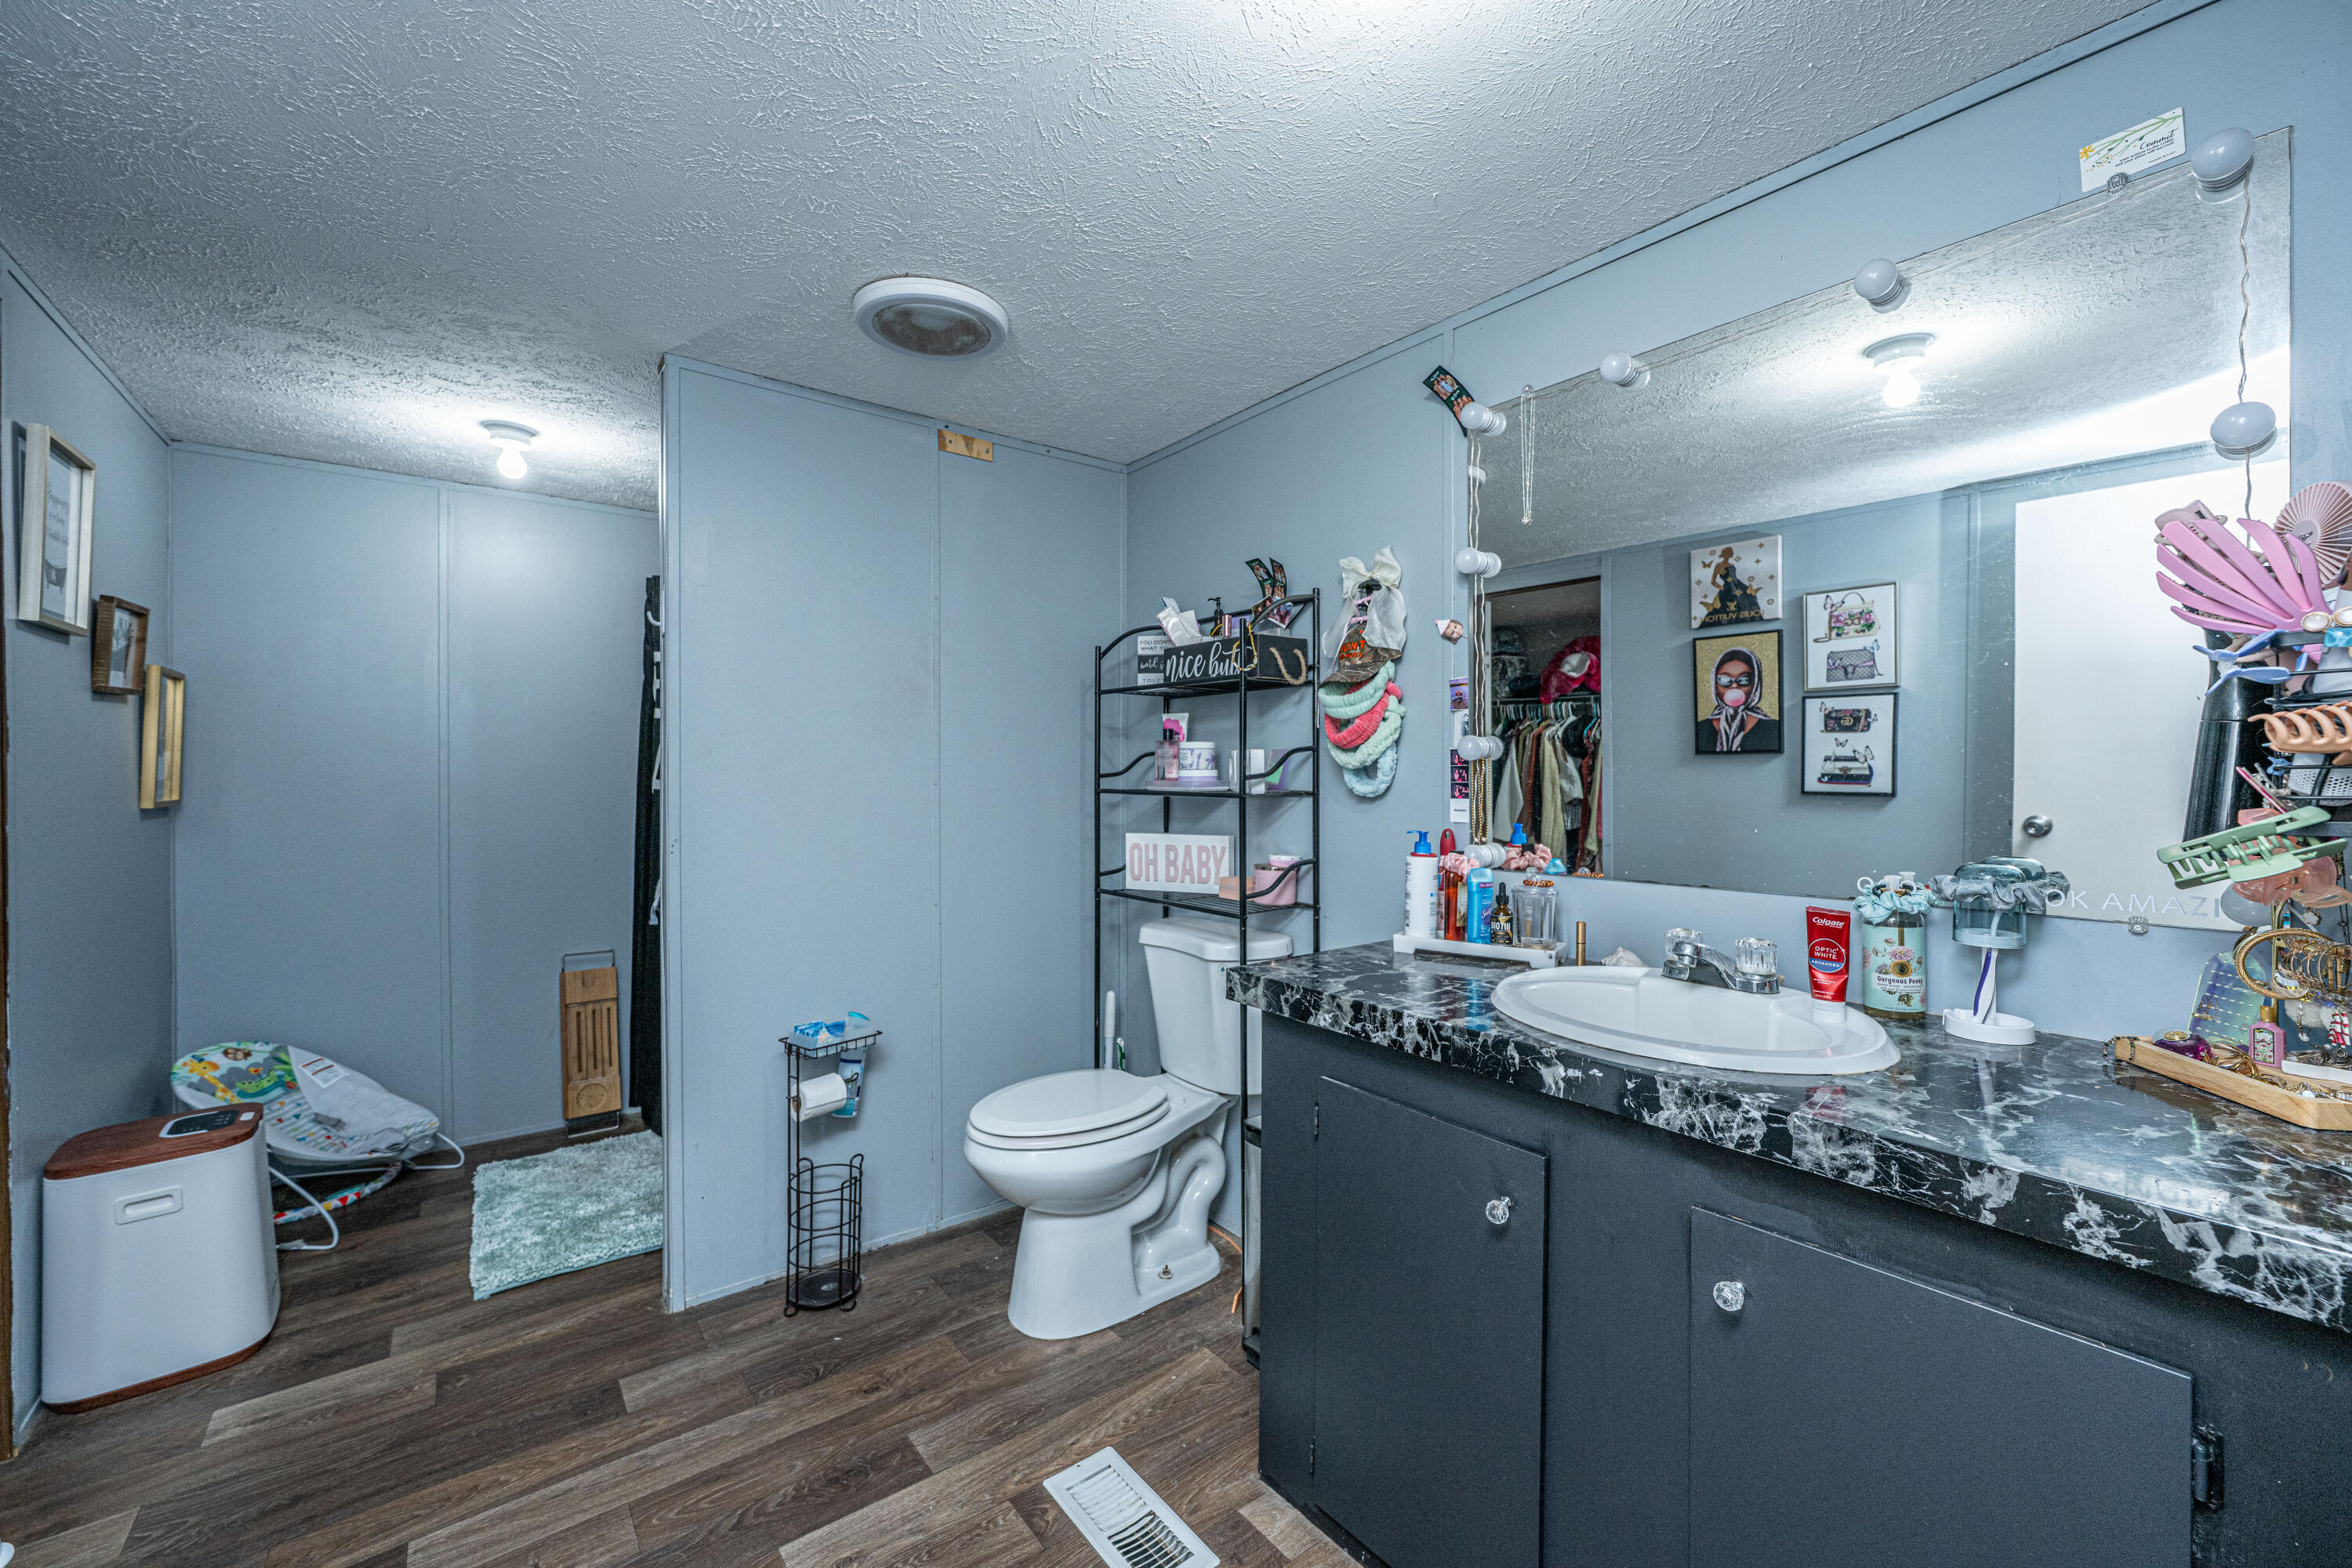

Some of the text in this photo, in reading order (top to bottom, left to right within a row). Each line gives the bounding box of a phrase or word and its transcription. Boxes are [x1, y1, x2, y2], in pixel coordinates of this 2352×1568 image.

[2140, 127, 2178, 149] Commit
[1165, 650, 1207, 683] nice
[1129, 842, 1227, 885] OH BABY
[2045, 889, 2220, 918] OK AMAZI
[1491, 921, 1510, 931] BIOTIN
[1812, 916, 1845, 927] Colgate
[1813, 951, 1837, 960] WHITE
[1814, 946, 1838, 954] OPTIC
[1877, 975, 1907, 985] Gorgeous
